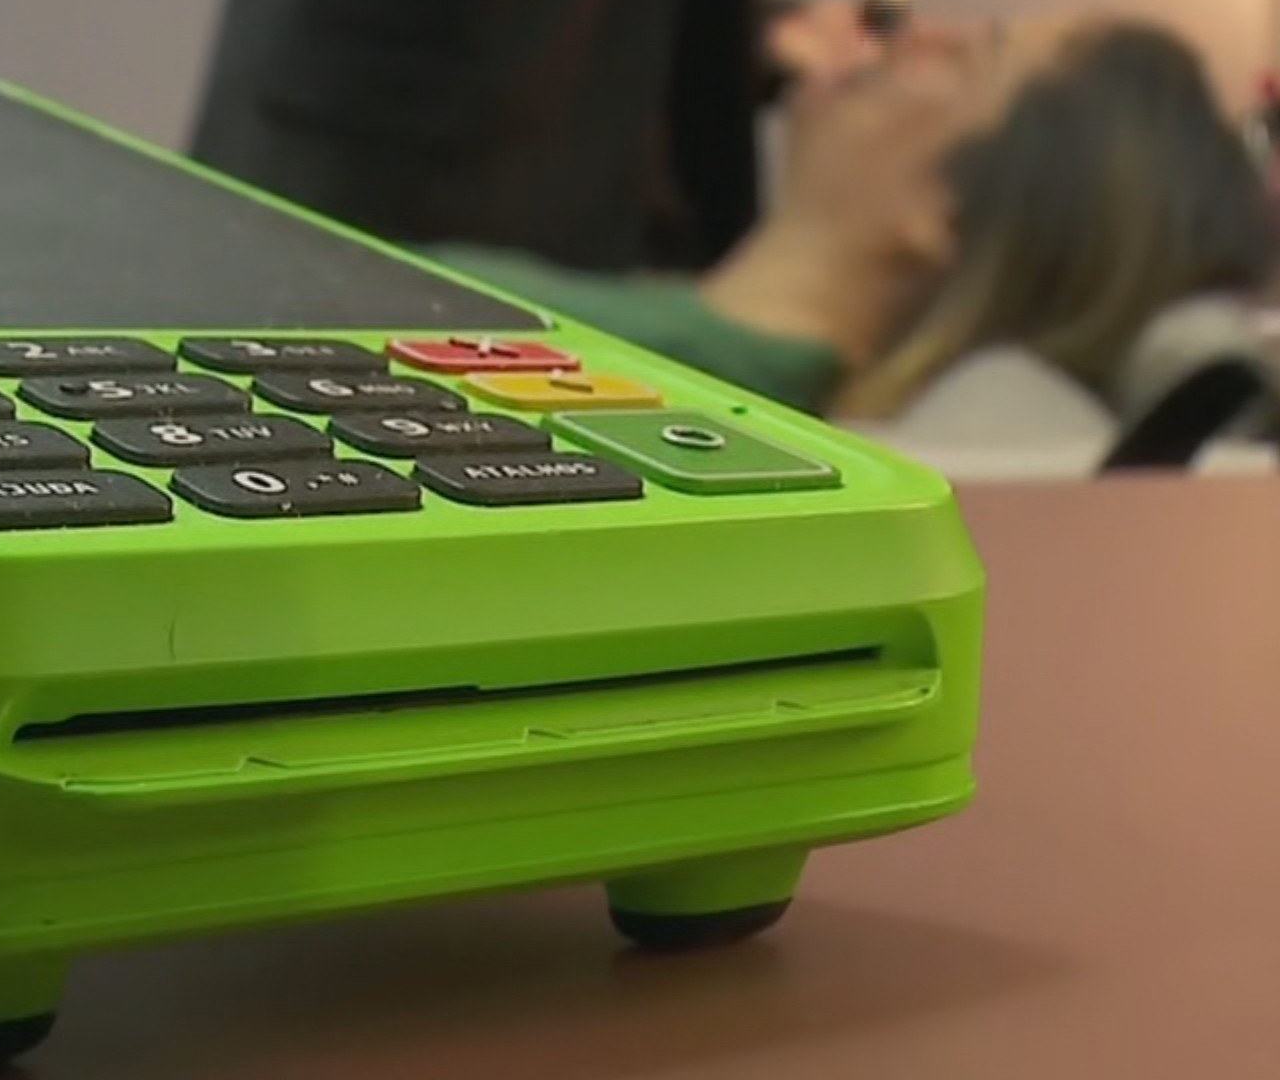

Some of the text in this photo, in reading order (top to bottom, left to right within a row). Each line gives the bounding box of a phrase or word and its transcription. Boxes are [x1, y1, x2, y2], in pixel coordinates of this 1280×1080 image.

[6, 342, 58, 359] 2
[230, 339, 277, 357] 3
[88, 380, 134, 399] 5
[309, 379, 354, 397] 6
[150, 424, 203, 445] 8
[381, 418, 430, 437] 9
[464, 462, 597, 479] ATALHOS
[232, 470, 287, 494] 0
